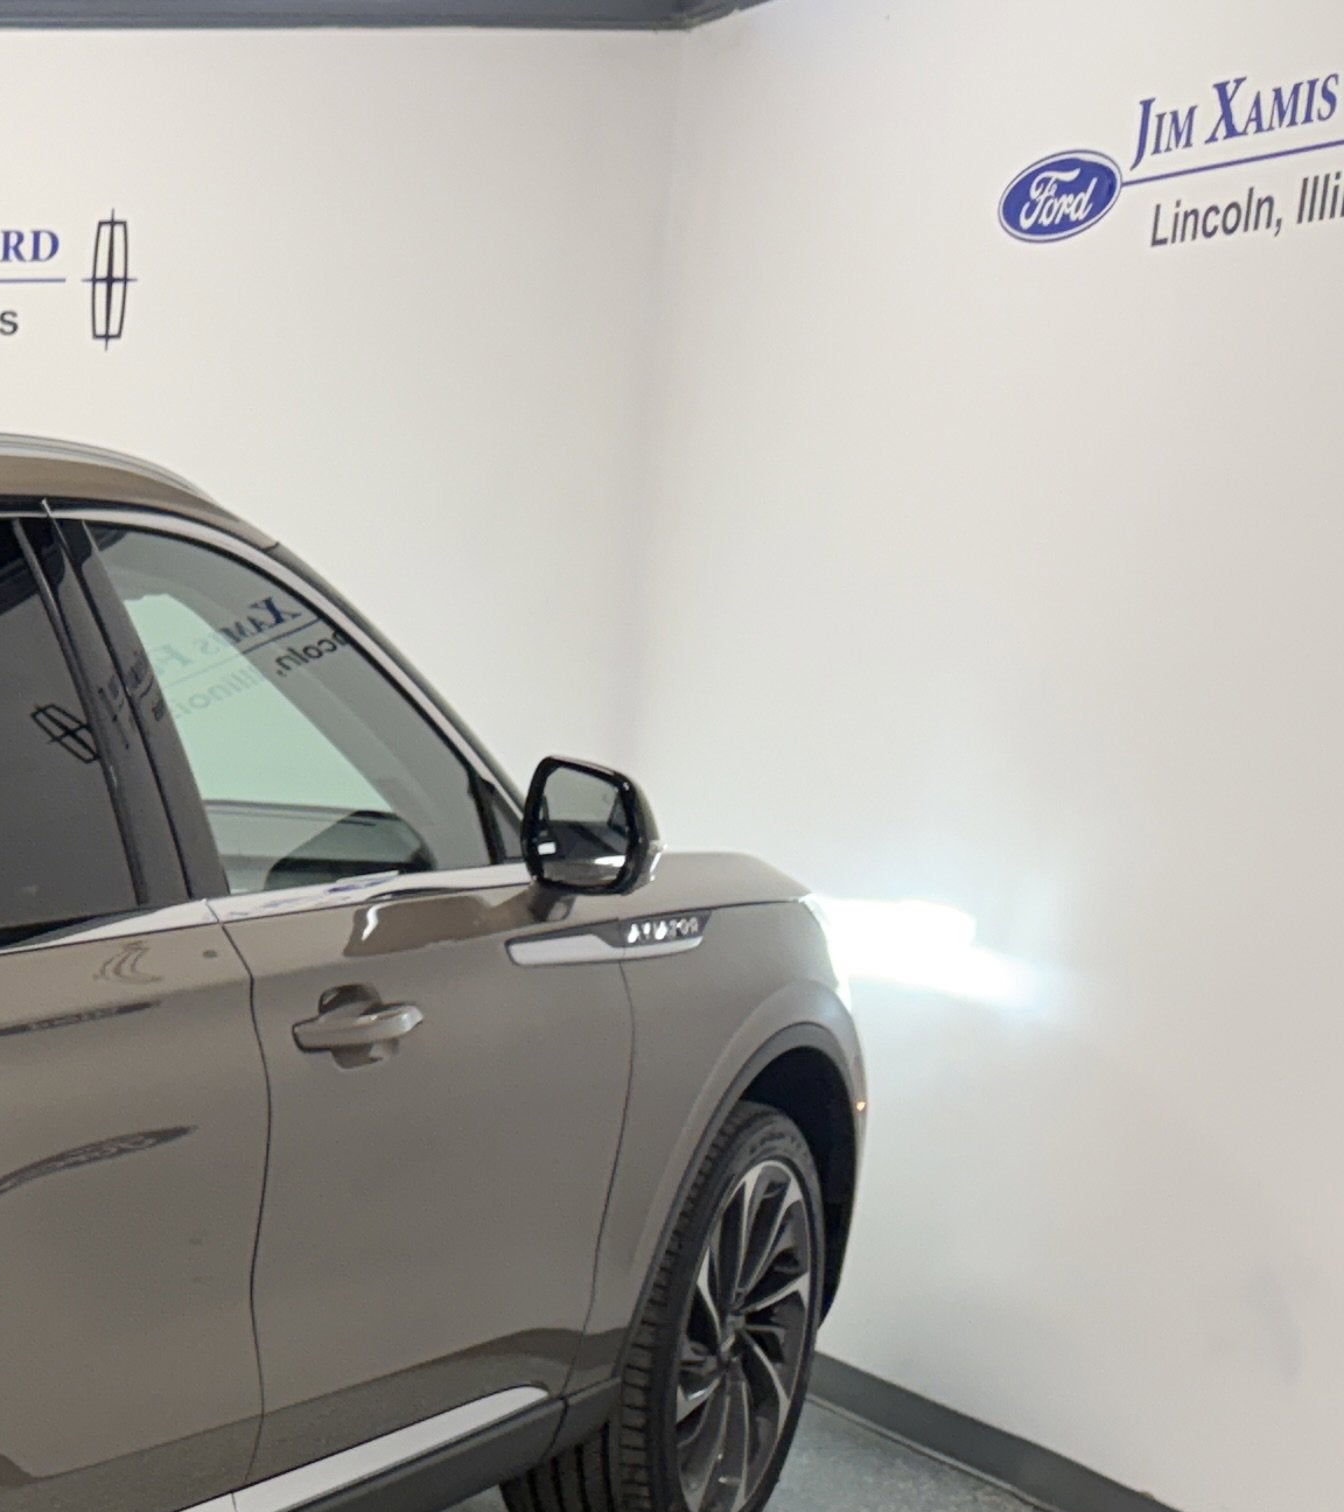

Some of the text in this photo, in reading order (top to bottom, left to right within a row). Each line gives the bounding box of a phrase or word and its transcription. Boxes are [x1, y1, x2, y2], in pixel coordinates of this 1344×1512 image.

[1130, 73, 1340, 171] JIM XAMIS
[1150, 171, 1344, 247] Lincoln, Illi
